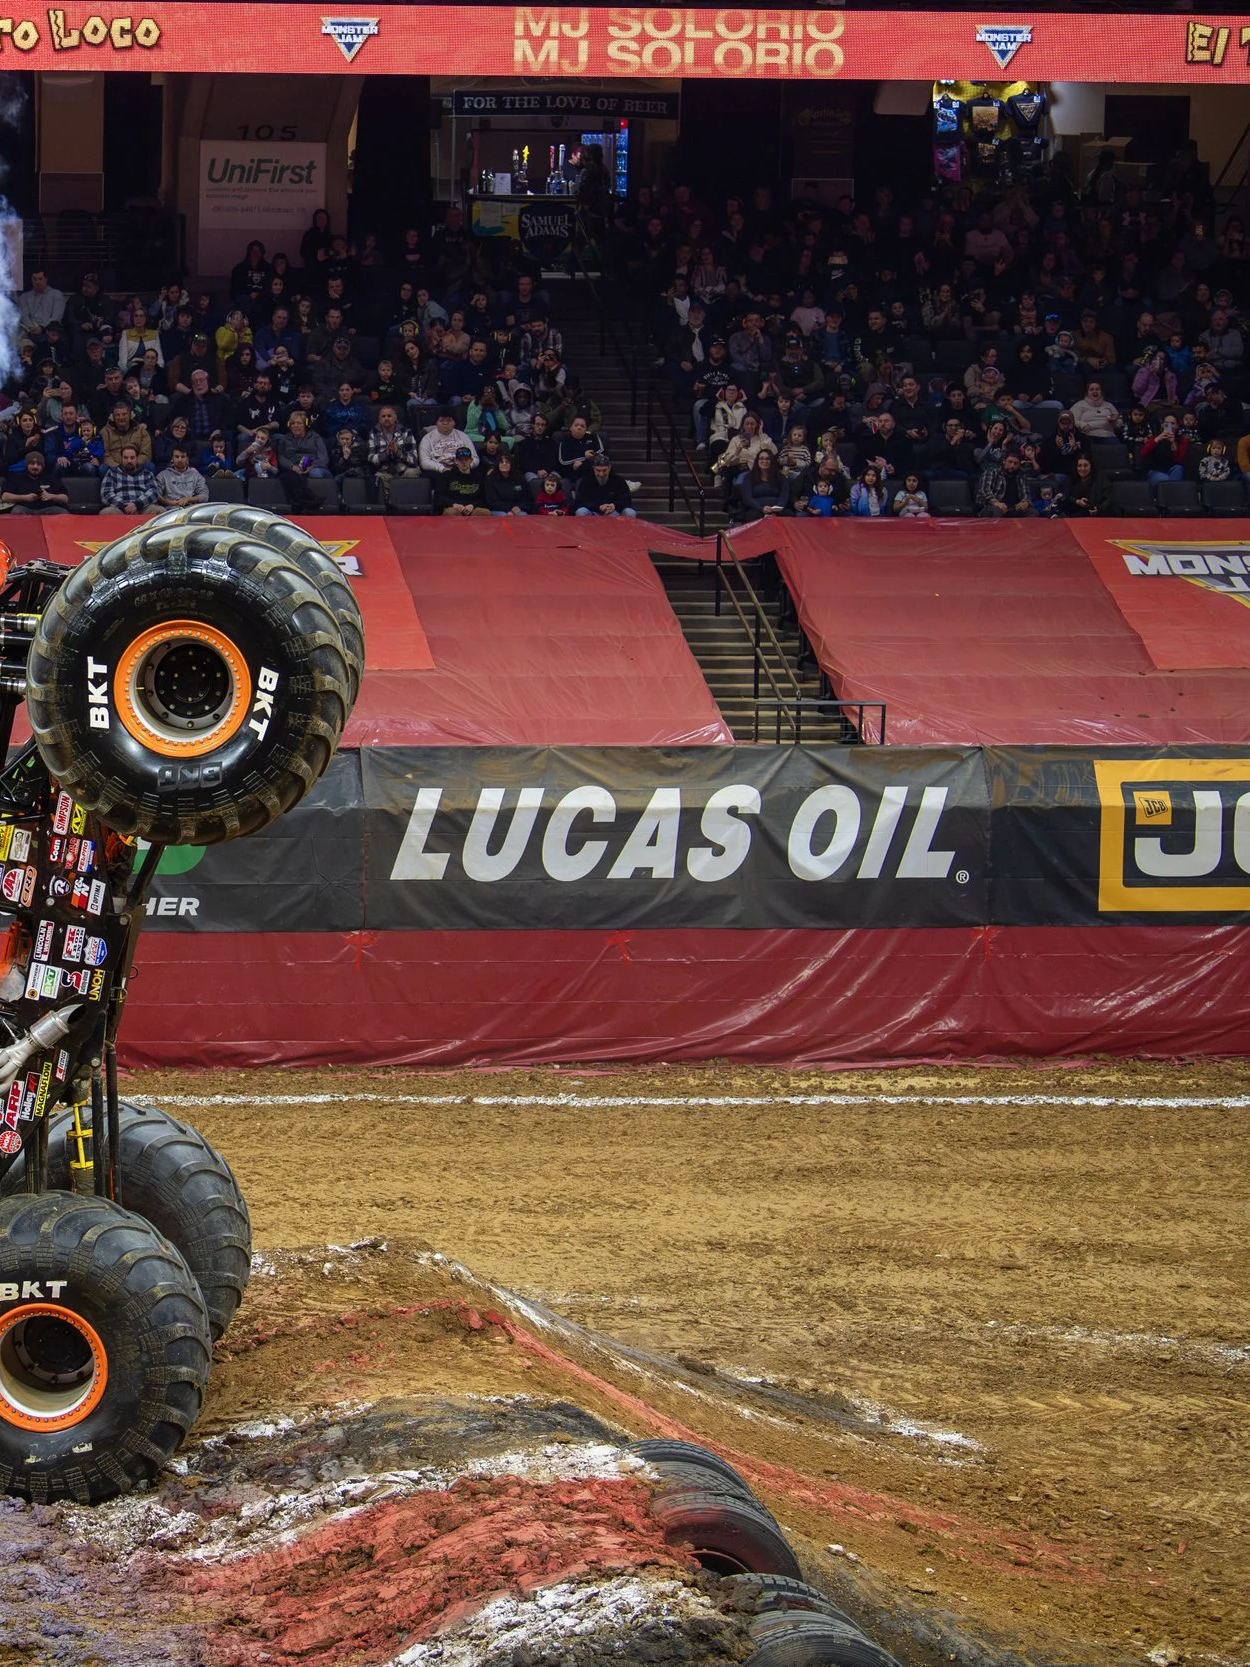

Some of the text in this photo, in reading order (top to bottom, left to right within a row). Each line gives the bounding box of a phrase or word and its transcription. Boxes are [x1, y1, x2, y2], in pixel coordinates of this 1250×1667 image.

[48, 8, 163, 51] Loco
[321, 24, 379, 35] MONSTER
[337, 34, 363, 44] JAM
[975, 33, 1032, 43] MONSTER
[514, 39, 845, 76] MJ SOLORIO
[991, 42, 1017, 51] JAM
[463, 95, 668, 114] FOR THE LOVE OF BEER
[238, 125, 298, 141] 105
[207, 157, 317, 184] UniFirst
[521, 213, 573, 228] SAMUEL
[525, 226, 569, 238] ADAMS
[87, 656, 110, 729] BKT
[248, 666, 279, 741] BKT
[56, 795, 71, 831] SIMPSON
[1145, 799, 1167, 816] JCB
[389, 784, 956, 882] LUCAS OIL
[49, 839, 61, 862] Coan
[2, 870, 17, 897] JAZ
[93, 885, 101, 904] OPTIMA
[35, 927, 46, 958] LINCOLN
[43, 968, 56, 995] BKT
[89, 969, 103, 1001] UNOH
[36, 1063, 51, 1115] MAGNAFLOW
[5, 1080, 22, 1128] ARP
[21, 1092, 35, 1119] Holley
